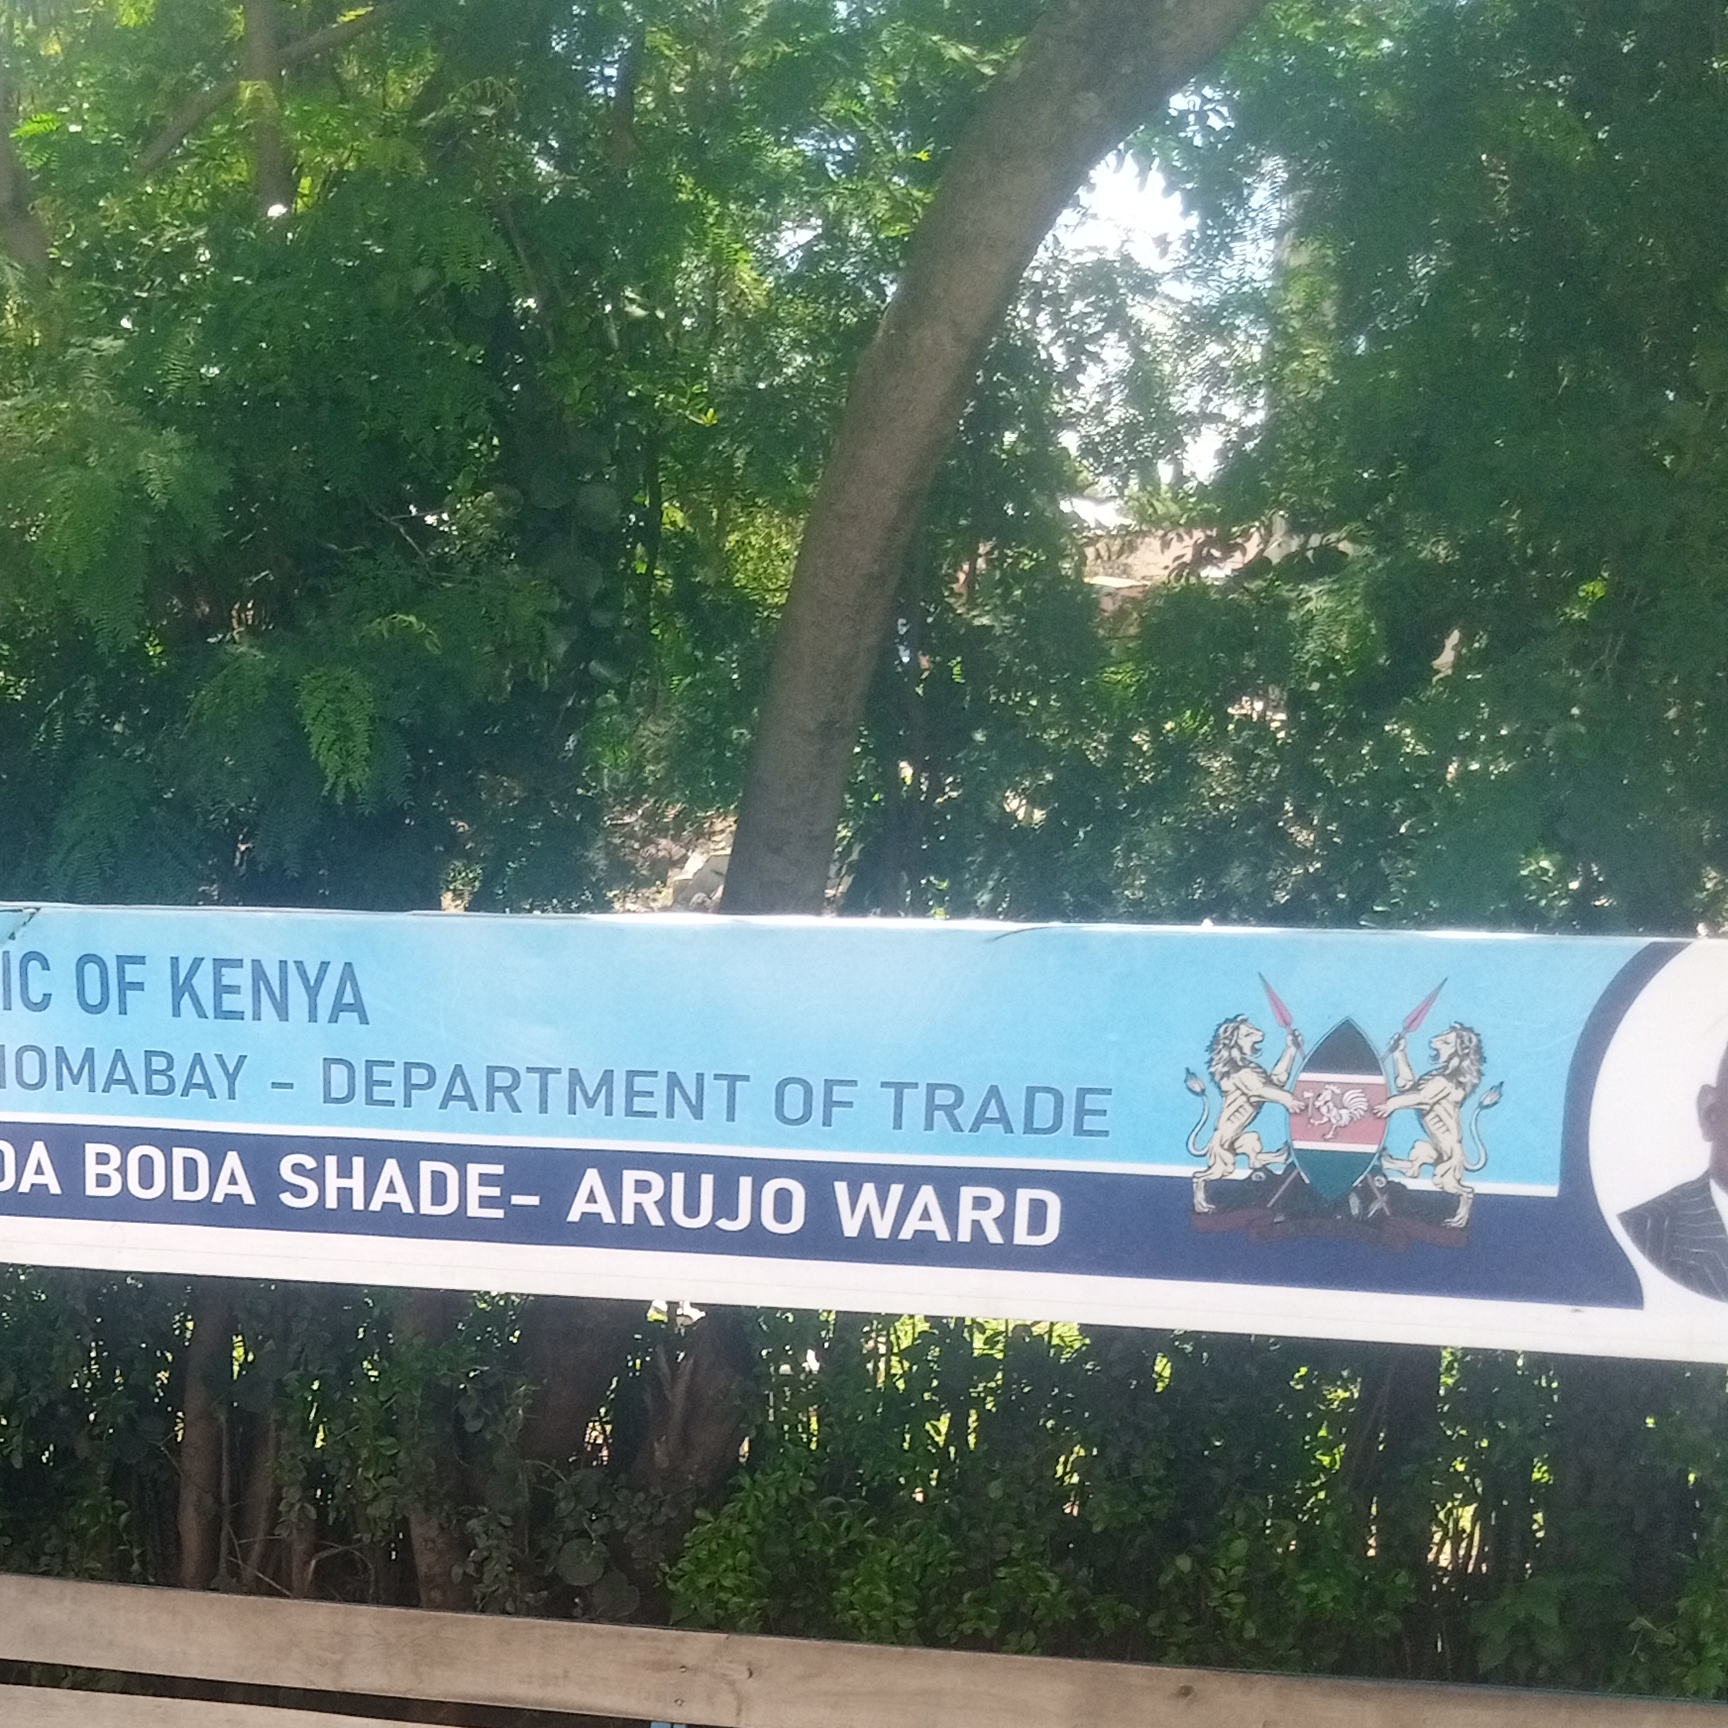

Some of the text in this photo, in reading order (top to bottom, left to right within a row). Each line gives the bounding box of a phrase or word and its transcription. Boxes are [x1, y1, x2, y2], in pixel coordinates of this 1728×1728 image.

[74, 953, 147, 1017] OF
[169, 956, 370, 1026] KENYA
[322, 1056, 750, 1123] DEPARTMENT
[773, 1076, 858, 1128] OF
[880, 1080, 1113, 1138] TRADE
[83, 1142, 256, 1206] BODA
[566, 1167, 806, 1235] ARUJO
[833, 1180, 1061, 1247] WARD
